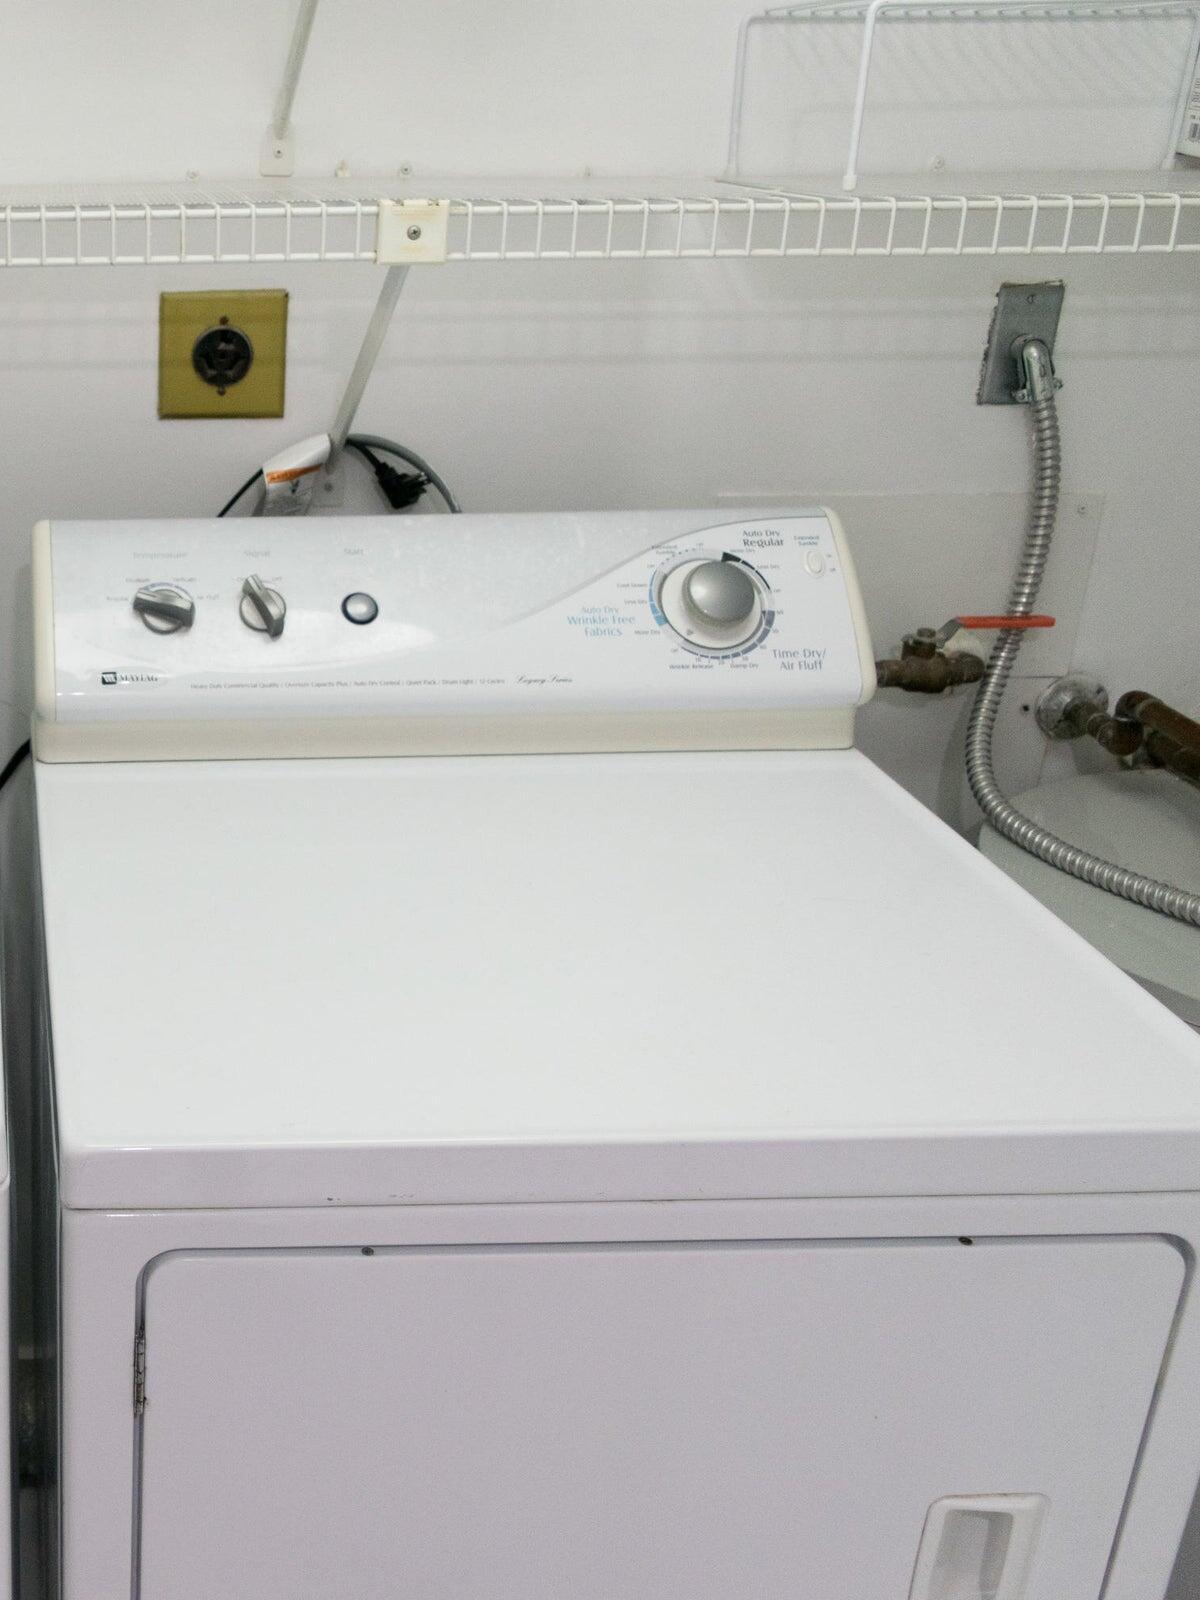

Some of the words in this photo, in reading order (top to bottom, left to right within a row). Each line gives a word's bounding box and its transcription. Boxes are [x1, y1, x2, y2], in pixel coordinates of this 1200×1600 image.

[742, 529, 762, 538] Auto
[765, 529, 780, 538] Dry
[742, 538, 785, 549] Regular
[567, 615, 609, 625] Wrinkle
[612, 615, 636, 624] Free
[584, 627, 623, 637] Fabrics
[772, 648, 801, 659] Time
[802, 648, 828, 660] Dry/
[780, 661, 797, 671] Air
[798, 661, 823, 672] Fluff
